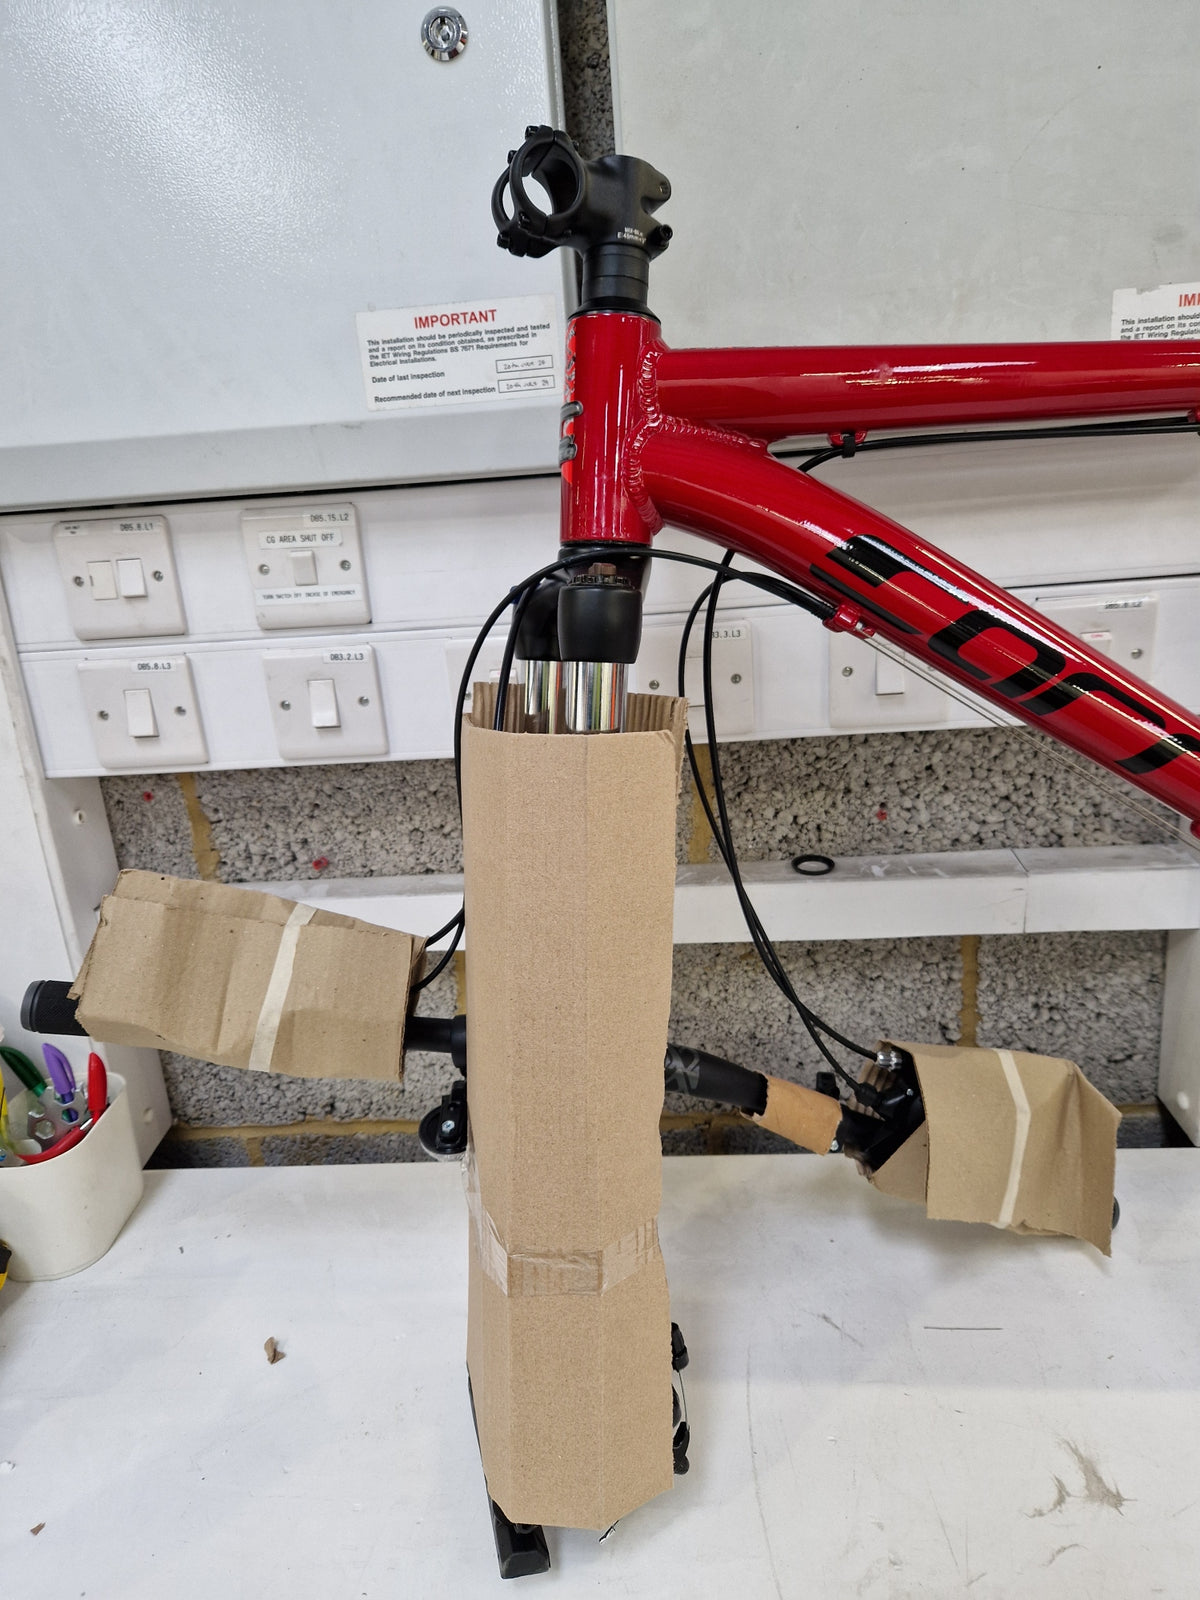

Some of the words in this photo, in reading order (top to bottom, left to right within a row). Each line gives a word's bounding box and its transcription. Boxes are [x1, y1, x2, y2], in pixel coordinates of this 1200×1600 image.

[1179, 293, 1200, 307] IM
[414, 309, 497, 329] IMPORTANT
[1138, 316, 1175, 324] installation
[448, 330, 482, 339] periodically
[484, 326, 514, 335] inspected
[496, 334, 530, 342] prescribed
[413, 348, 448, 356] Regulations
[476, 341, 518, 350] Requirements
[410, 371, 445, 380] inspection
[374, 392, 422, 403] Recommended
[424, 391, 437, 399] date
[462, 386, 496, 395] inspection
[310, 513, 349, 522] DB5.15.L2
[322, 533, 334, 541] OFF
[330, 653, 364, 662] DB3.2.L3
[138, 662, 172, 671] DB5.8.L3
